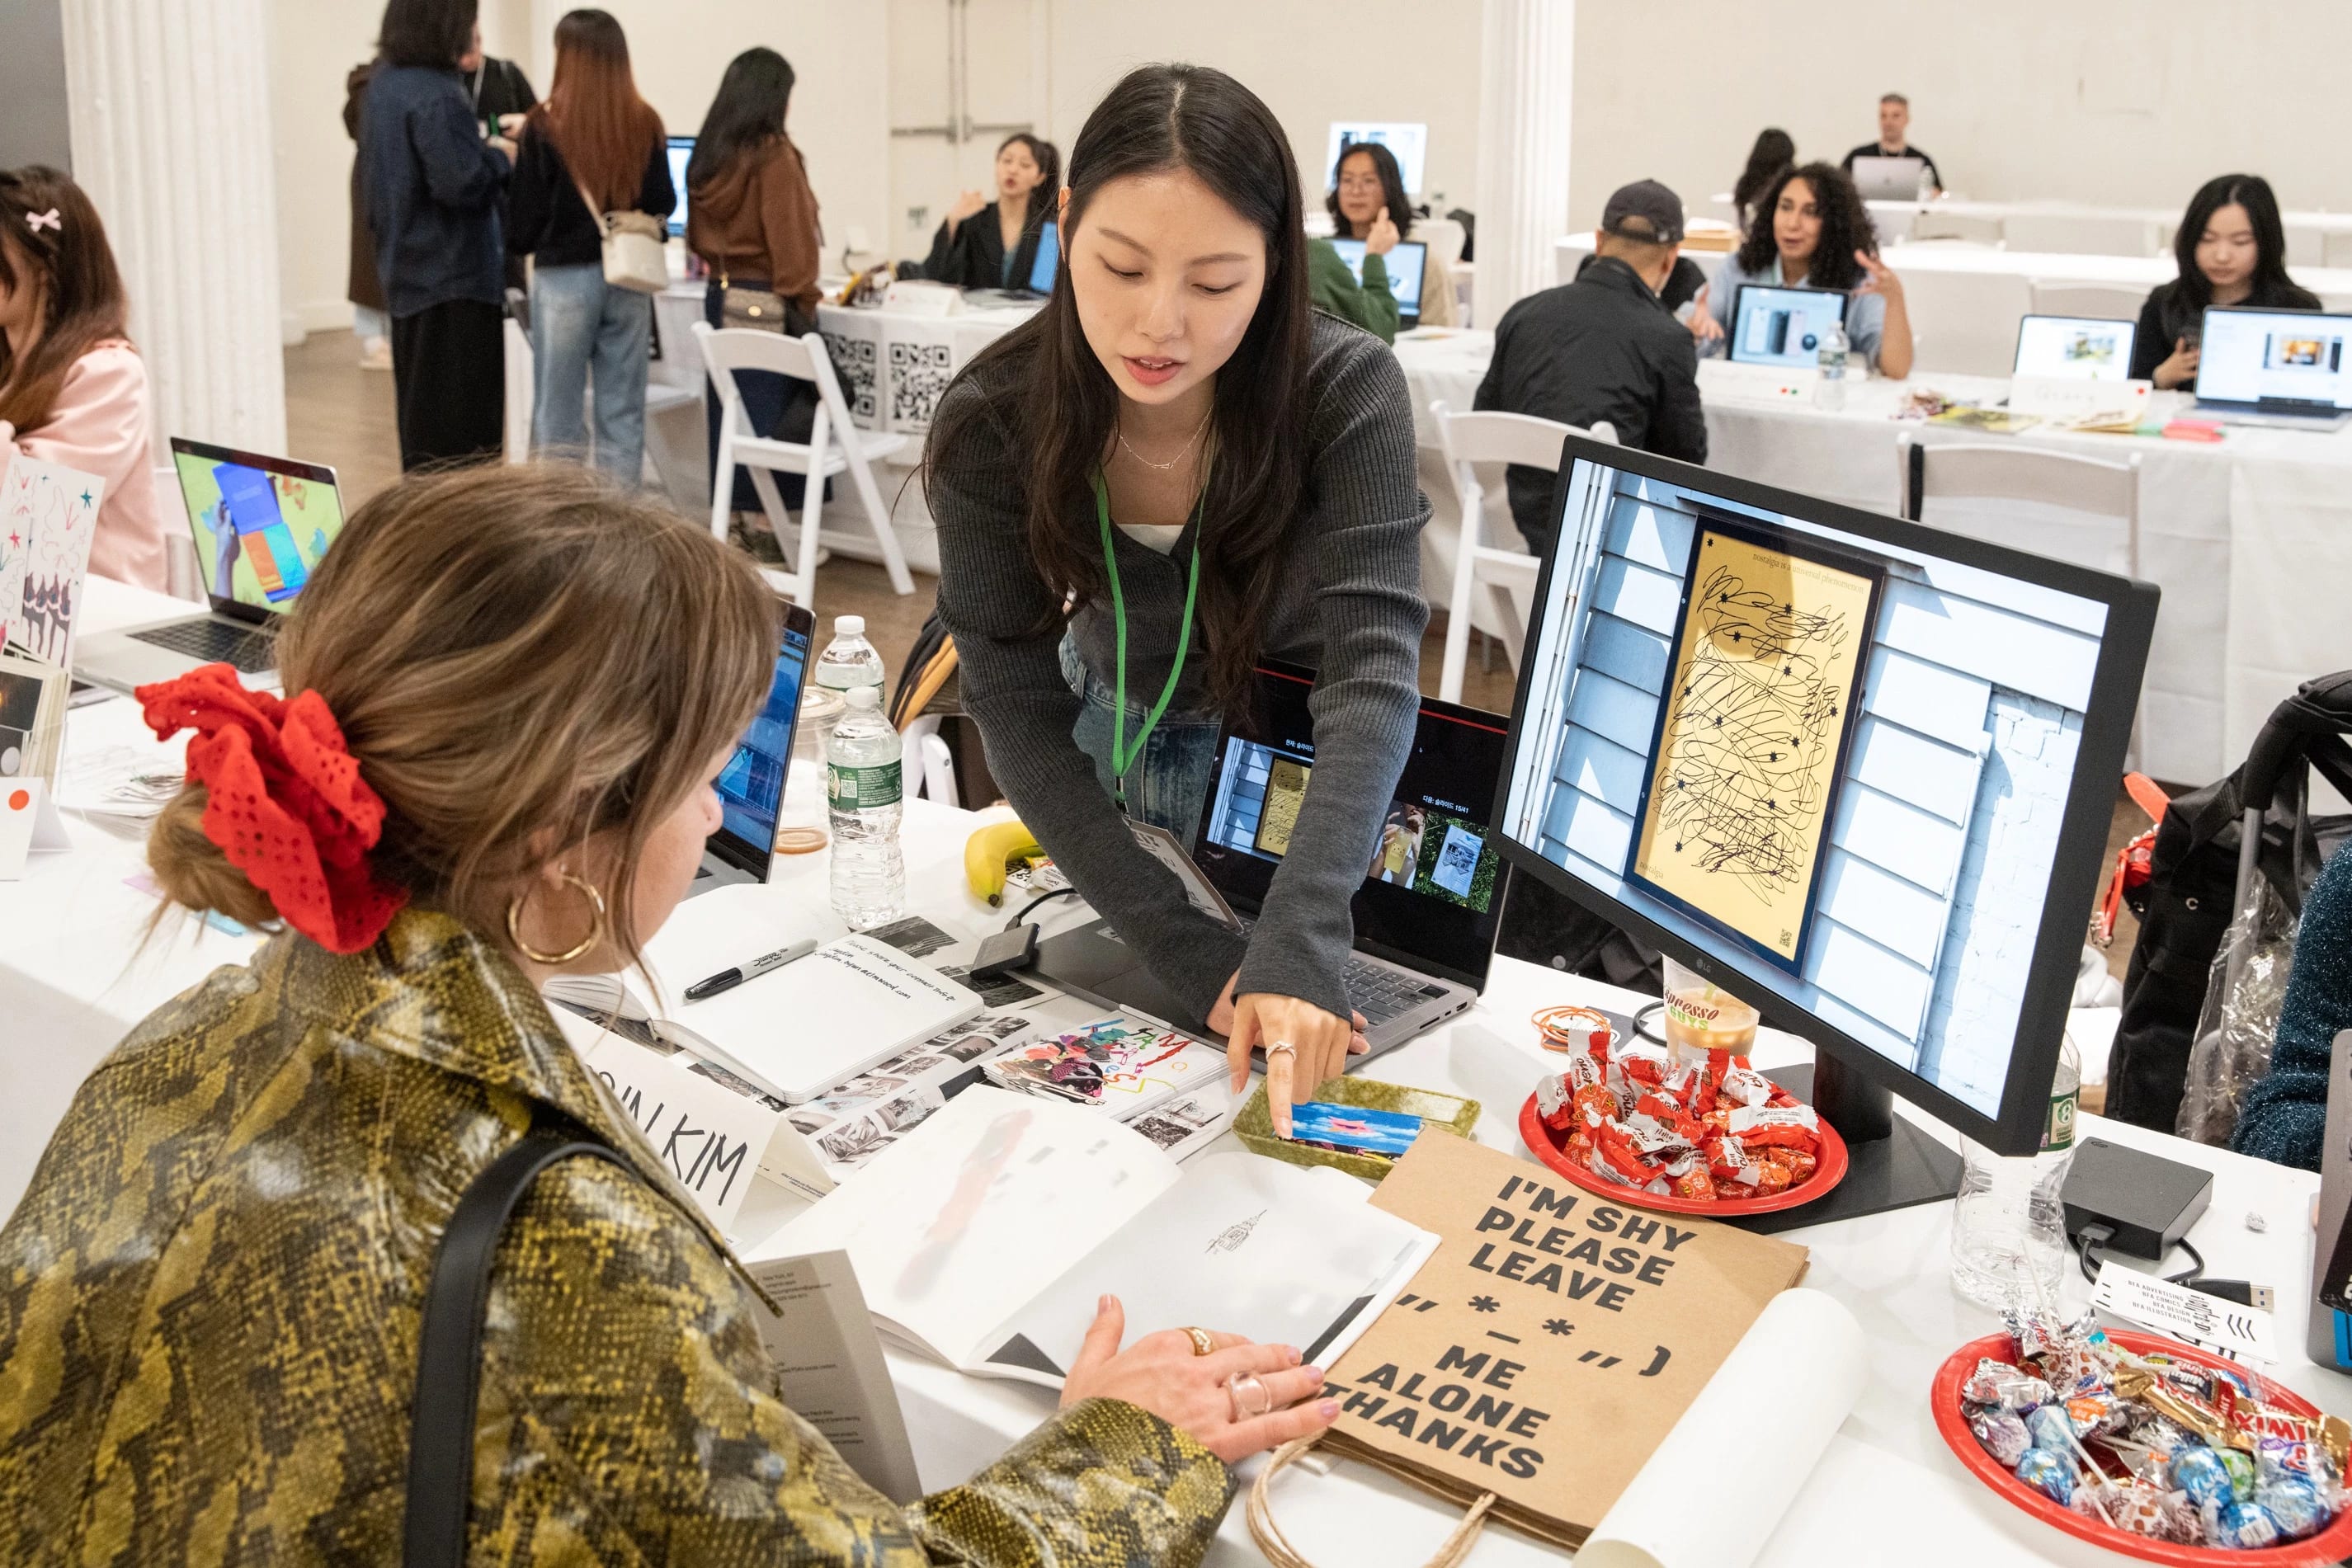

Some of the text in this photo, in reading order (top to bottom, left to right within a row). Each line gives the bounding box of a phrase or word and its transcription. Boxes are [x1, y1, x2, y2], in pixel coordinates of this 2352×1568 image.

[1752, 553, 1779, 568] nostalgia
[1792, 566, 1821, 580] universal
[1821, 573, 1864, 595] phenomenon
[1422, 794, 1469, 814] 다음: 슬라이드 15/41
[867, 950, 890, 964] share
[1703, 963, 1711, 973] LG
[1664, 987, 1720, 1021] spresso
[1670, 1005, 1709, 1031] GUYS
[662, 1113, 748, 1207] KIM
[1497, 1175, 1699, 1252] I'M SHY
[1474, 1206, 1676, 1286] PLEASE
[1468, 1242, 1636, 1312] LEAVE
[2142, 1283, 2185, 1302] ADVERTISING
[2146, 1305, 2192, 1325] ILLUSTRATION
[2156, 1294, 2181, 1307] COMICS
[2166, 1303, 2191, 1318] DESIGN
[1435, 1344, 1526, 1391] ME
[1356, 1362, 1551, 1439] ALONE
[1322, 1381, 1545, 1480] THANKS
